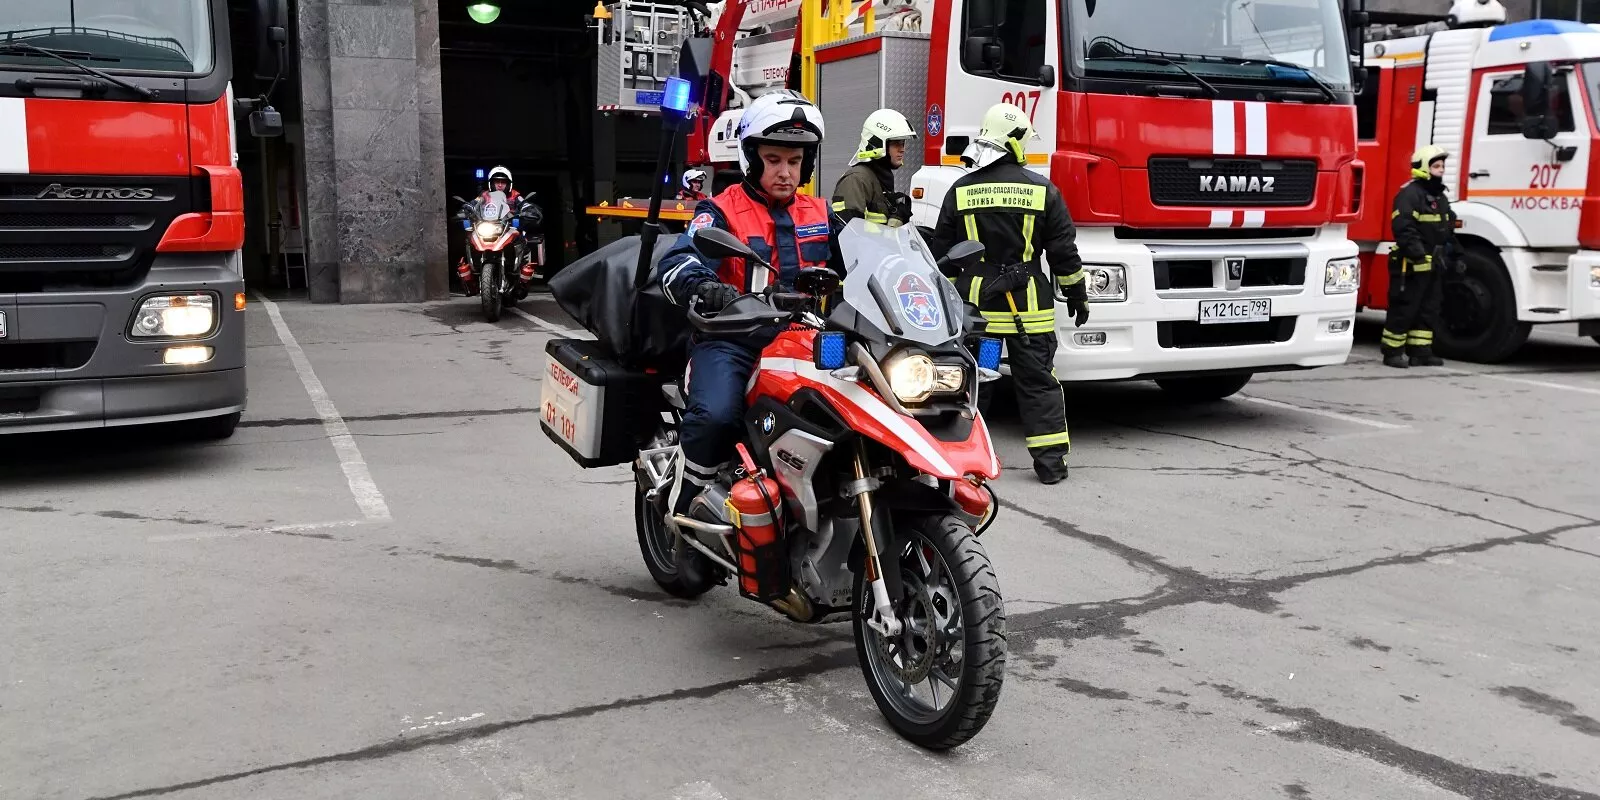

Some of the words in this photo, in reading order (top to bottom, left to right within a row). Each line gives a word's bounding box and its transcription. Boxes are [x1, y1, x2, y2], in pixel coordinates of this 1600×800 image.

[1200, 175, 1275, 193] KAMAZ
[1530, 164, 1562, 189] 207
[966, 186, 1034, 196] ПОЖАРНО-СПАСАТЕЛЬНАЯ
[967, 197, 995, 207] СЛУЖБА
[1002, 197, 1033, 207] МОСКВЫ
[1511, 196, 1582, 210] МОСКВА
[1251, 301, 1267, 312] 799
[550, 363, 579, 397] ТЕЛЕФОН
[546, 402, 556, 427] 01
[561, 414, 575, 444] 101
[777, 449, 805, 471] GS
